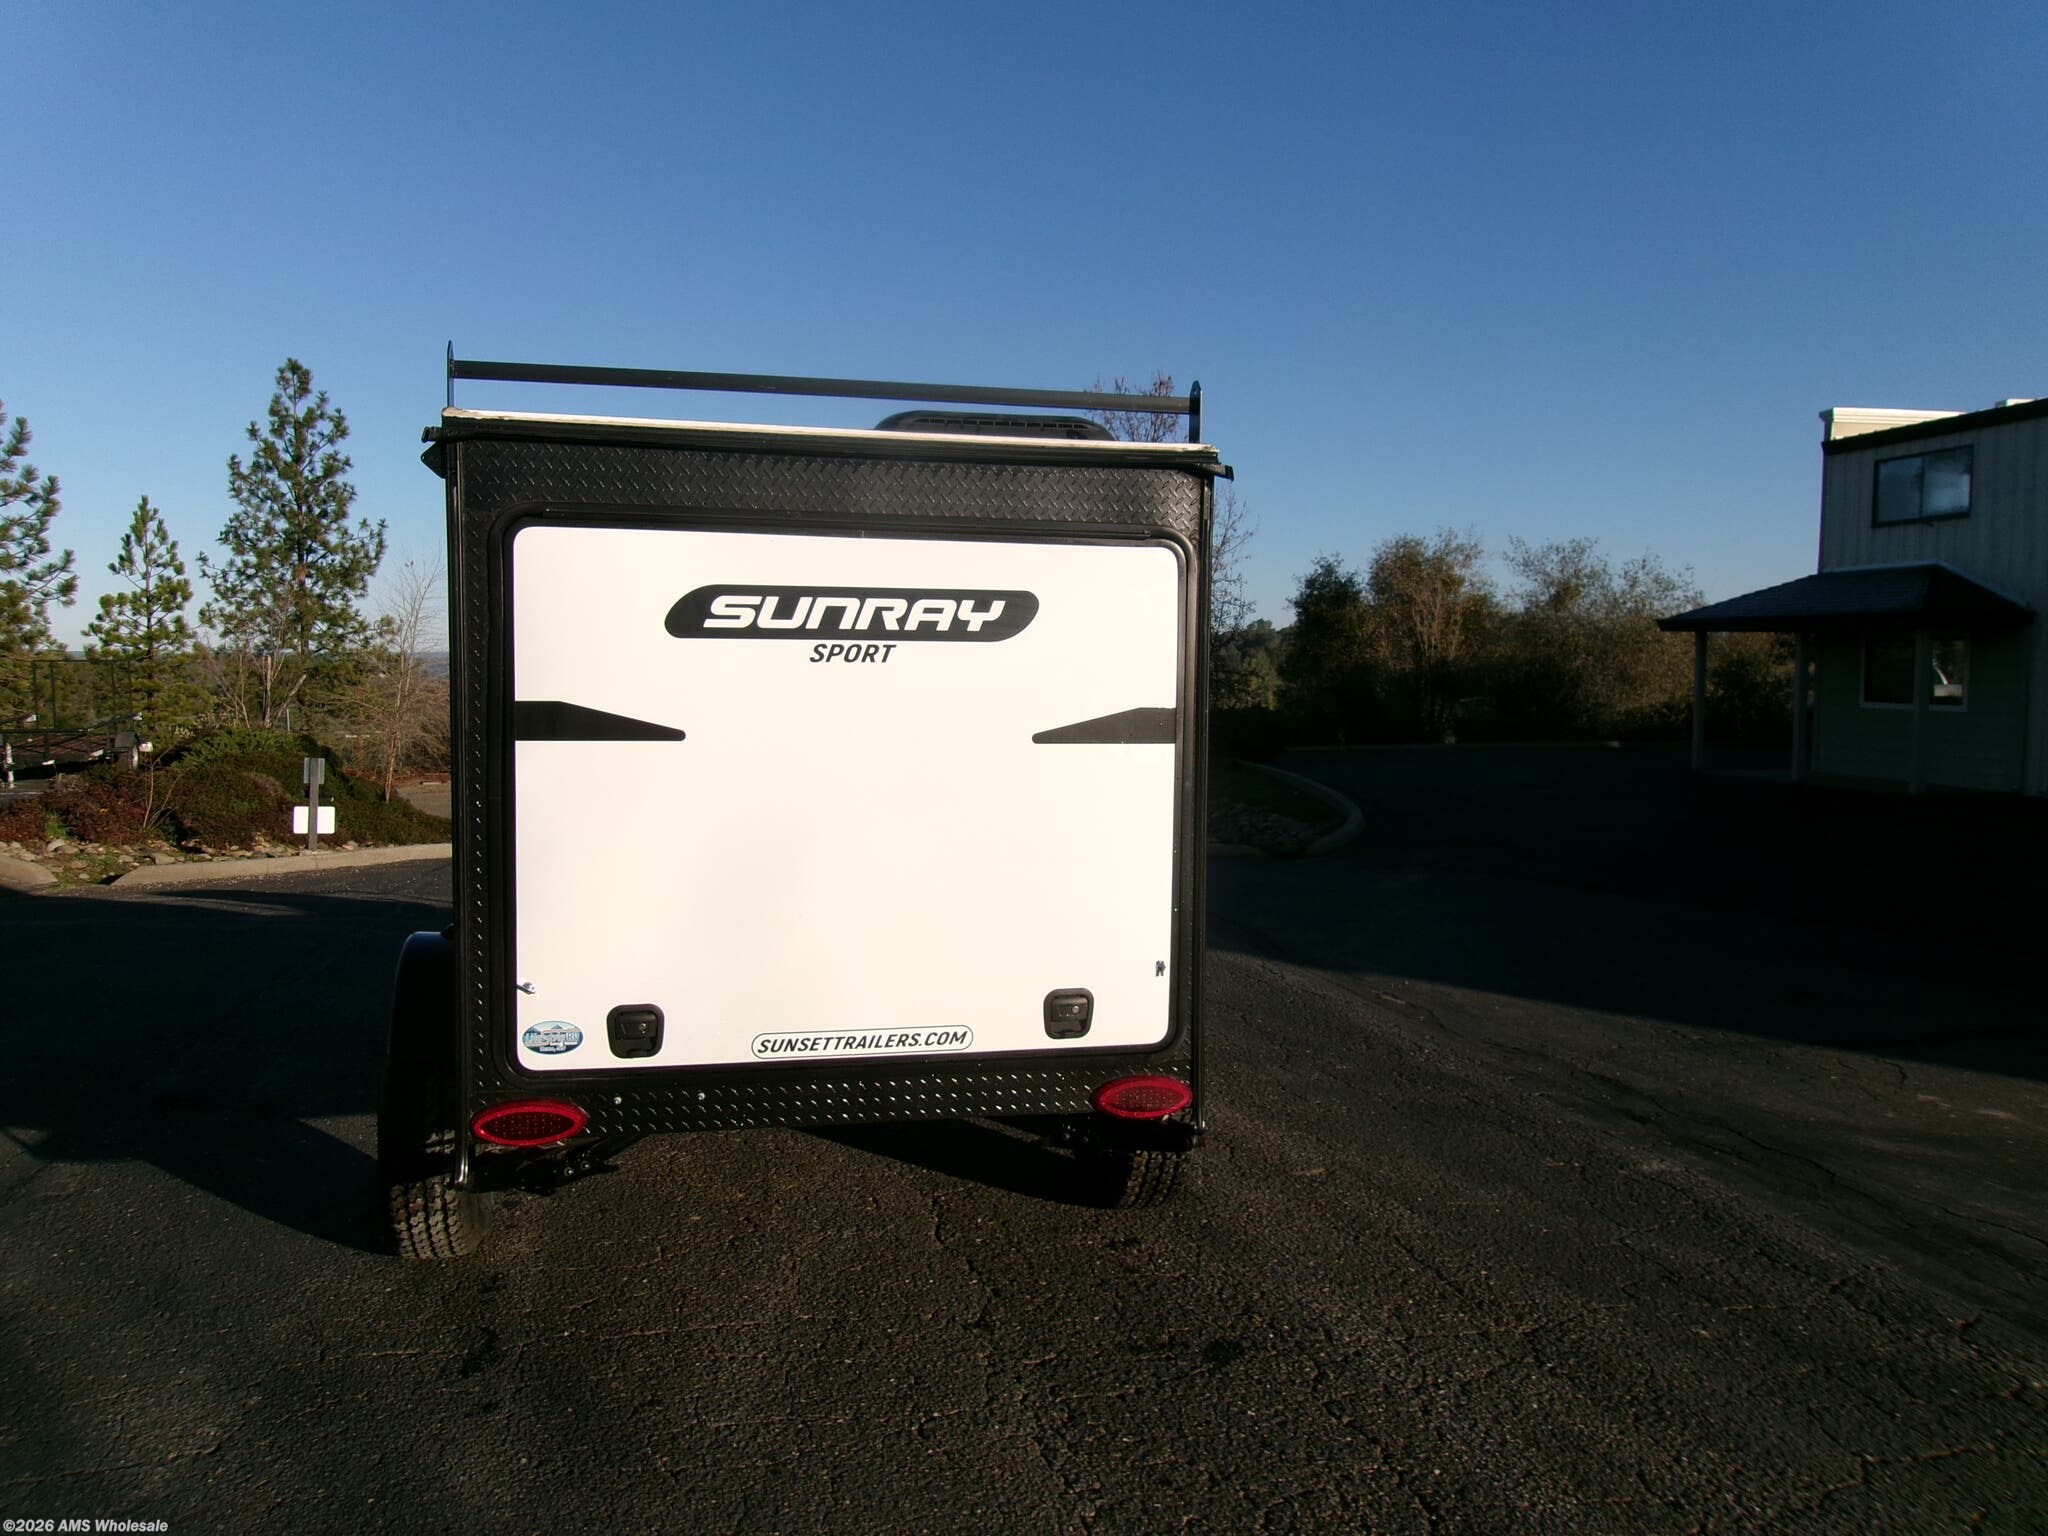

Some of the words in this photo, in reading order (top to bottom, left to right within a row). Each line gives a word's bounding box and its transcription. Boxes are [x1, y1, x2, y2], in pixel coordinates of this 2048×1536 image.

[703, 595, 1006, 632] SUNRAY
[809, 643, 896, 663] SPORT
[757, 1030, 968, 1053] SUNSETTRAILERS.COM
